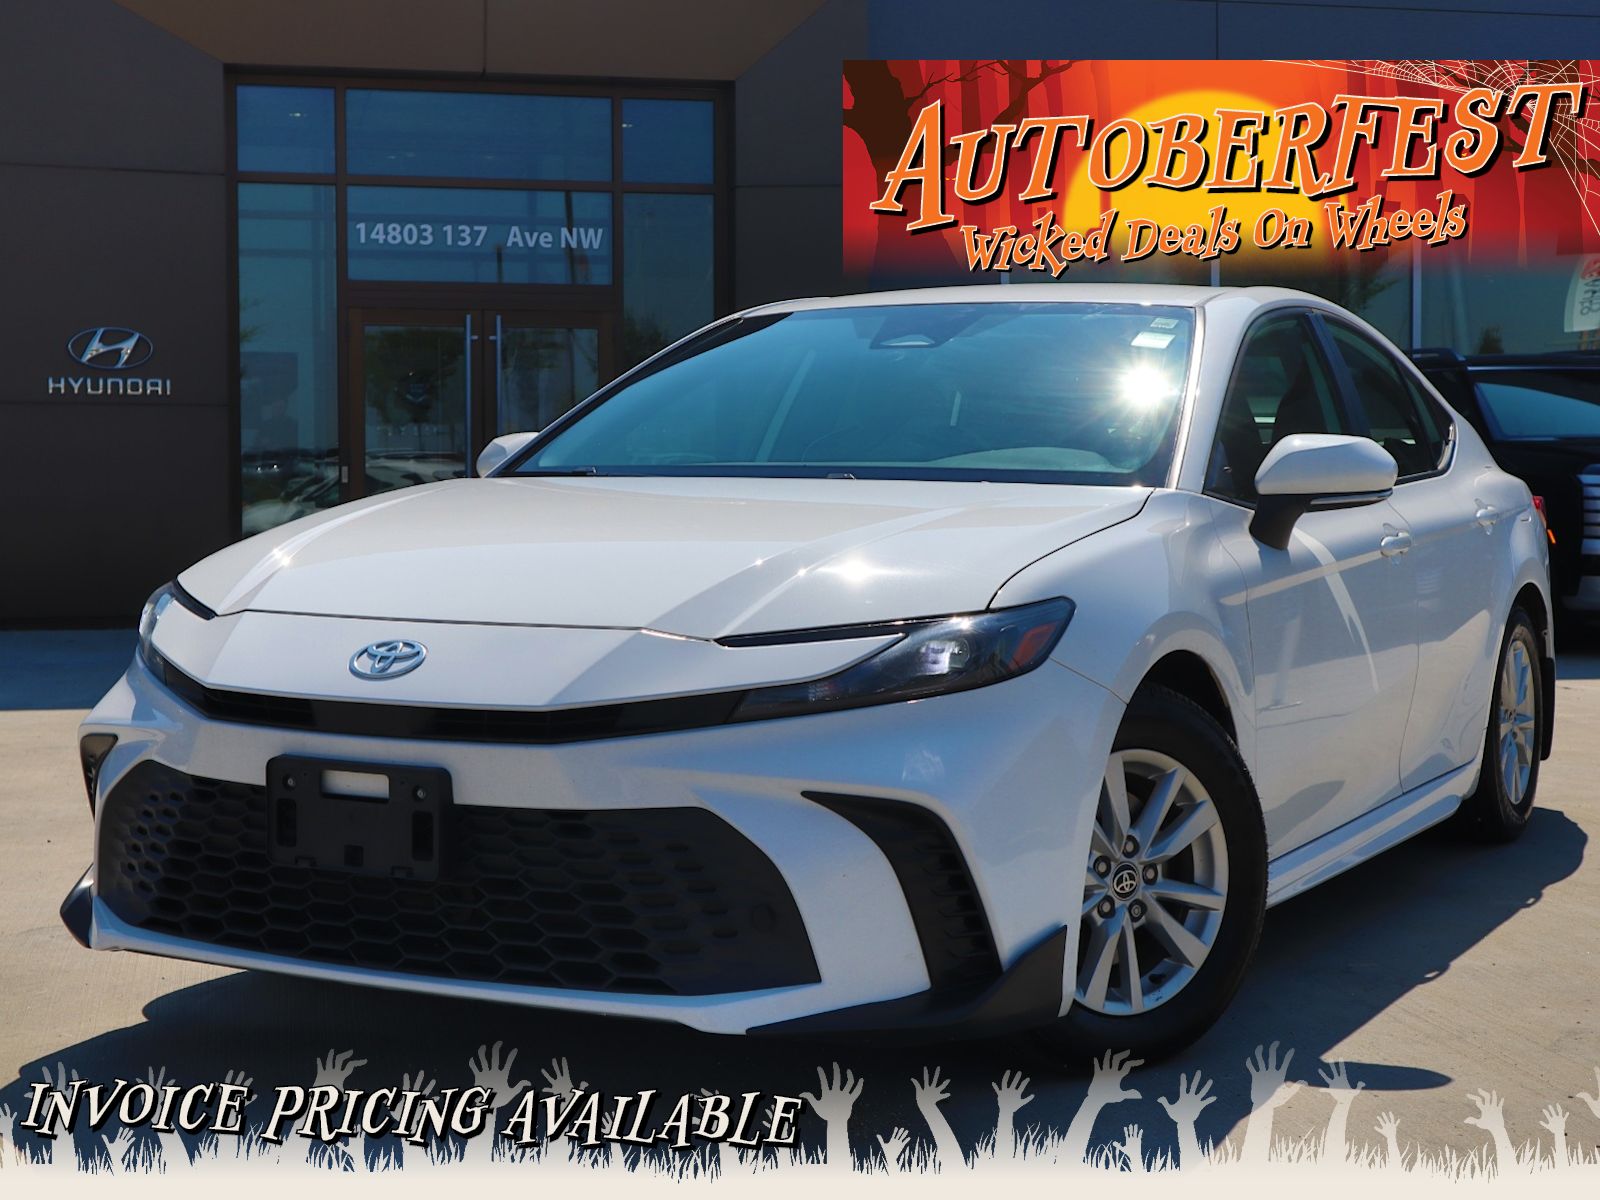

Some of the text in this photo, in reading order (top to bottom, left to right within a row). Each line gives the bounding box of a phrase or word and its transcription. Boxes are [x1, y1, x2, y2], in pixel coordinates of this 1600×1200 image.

[355, 222, 603, 249] 14803 137 Ave NW
[48, 376, 171, 396] HYUNDAI
